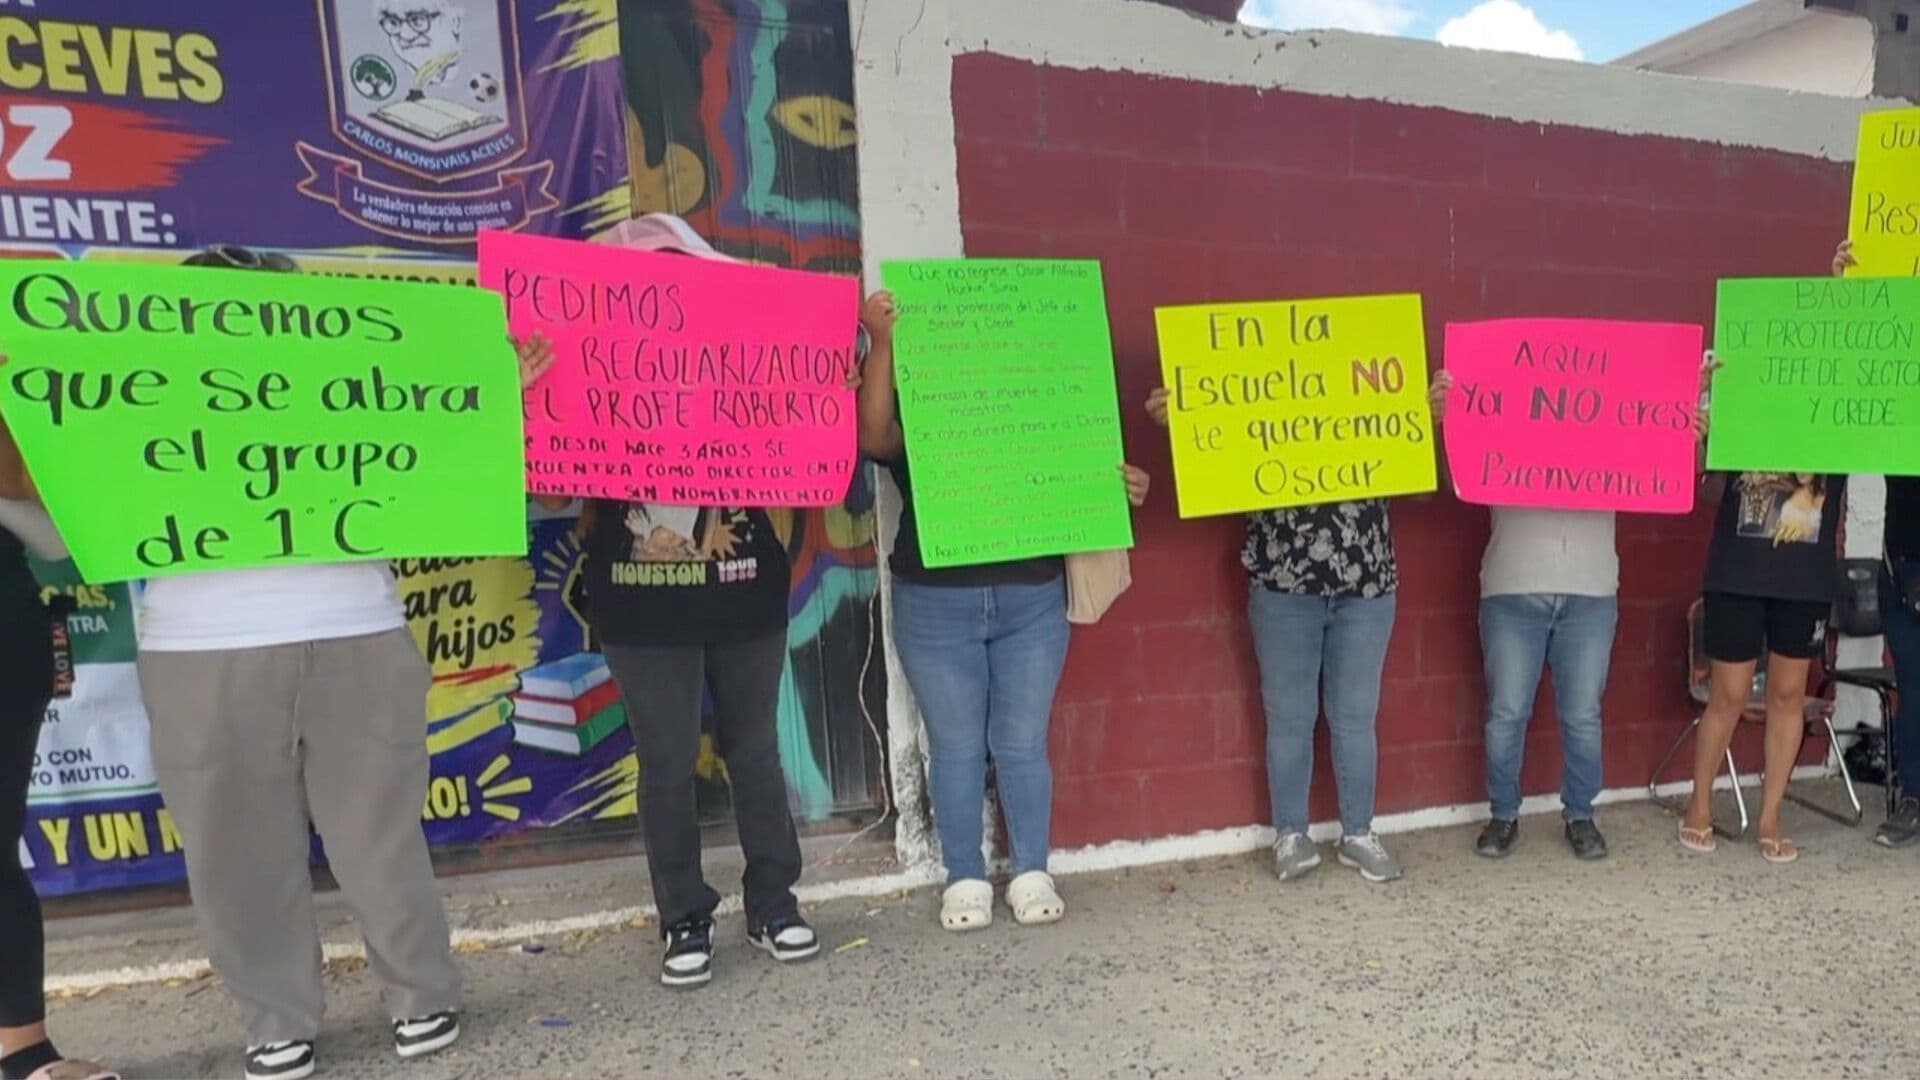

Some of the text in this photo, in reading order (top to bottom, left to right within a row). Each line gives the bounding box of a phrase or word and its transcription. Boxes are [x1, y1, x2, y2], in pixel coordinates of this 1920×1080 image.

[343, 121, 393, 154] CARLOS
[471, 133, 515, 162] ACEVES
[353, 186, 367, 204] La
[13, 274, 403, 342] Queremos
[504, 267, 684, 332] PEDIMOS
[1796, 280, 1892, 311] BASTA
[1208, 304, 1331, 350] En la
[582, 336, 849, 385] REGULARIZACION
[1759, 356, 1811, 386] JEFE
[1818, 357, 1844, 387] DE
[12, 366, 480, 425] que se abra
[1175, 357, 1404, 412] Escuela NO
[587, 387, 693, 429] PROFE
[714, 389, 839, 428] ROBERTO
[1530, 385, 1602, 423] NO
[1618, 399, 1690, 431] eres
[1809, 396, 1897, 427] Y CREDE
[551, 436, 608, 452] DESDE
[697, 439, 751, 460] AÑOS
[765, 439, 786, 457] SE
[1192, 410, 1424, 452] te queremos
[144, 430, 418, 500] el grupo
[646, 464, 694, 478] COMO
[707, 464, 796, 480] DIRECTOR
[807, 460, 828, 476] EN
[1254, 458, 1383, 496] Oscar
[136, 515, 229, 568] de
[611, 561, 706, 586] HOUSTON
[427, 614, 515, 669] hijos
[49, 748, 92, 765] CON
[60, 764, 135, 786] MUTUO.
[39, 818, 70, 864] Y
[84, 811, 150, 861] UN
